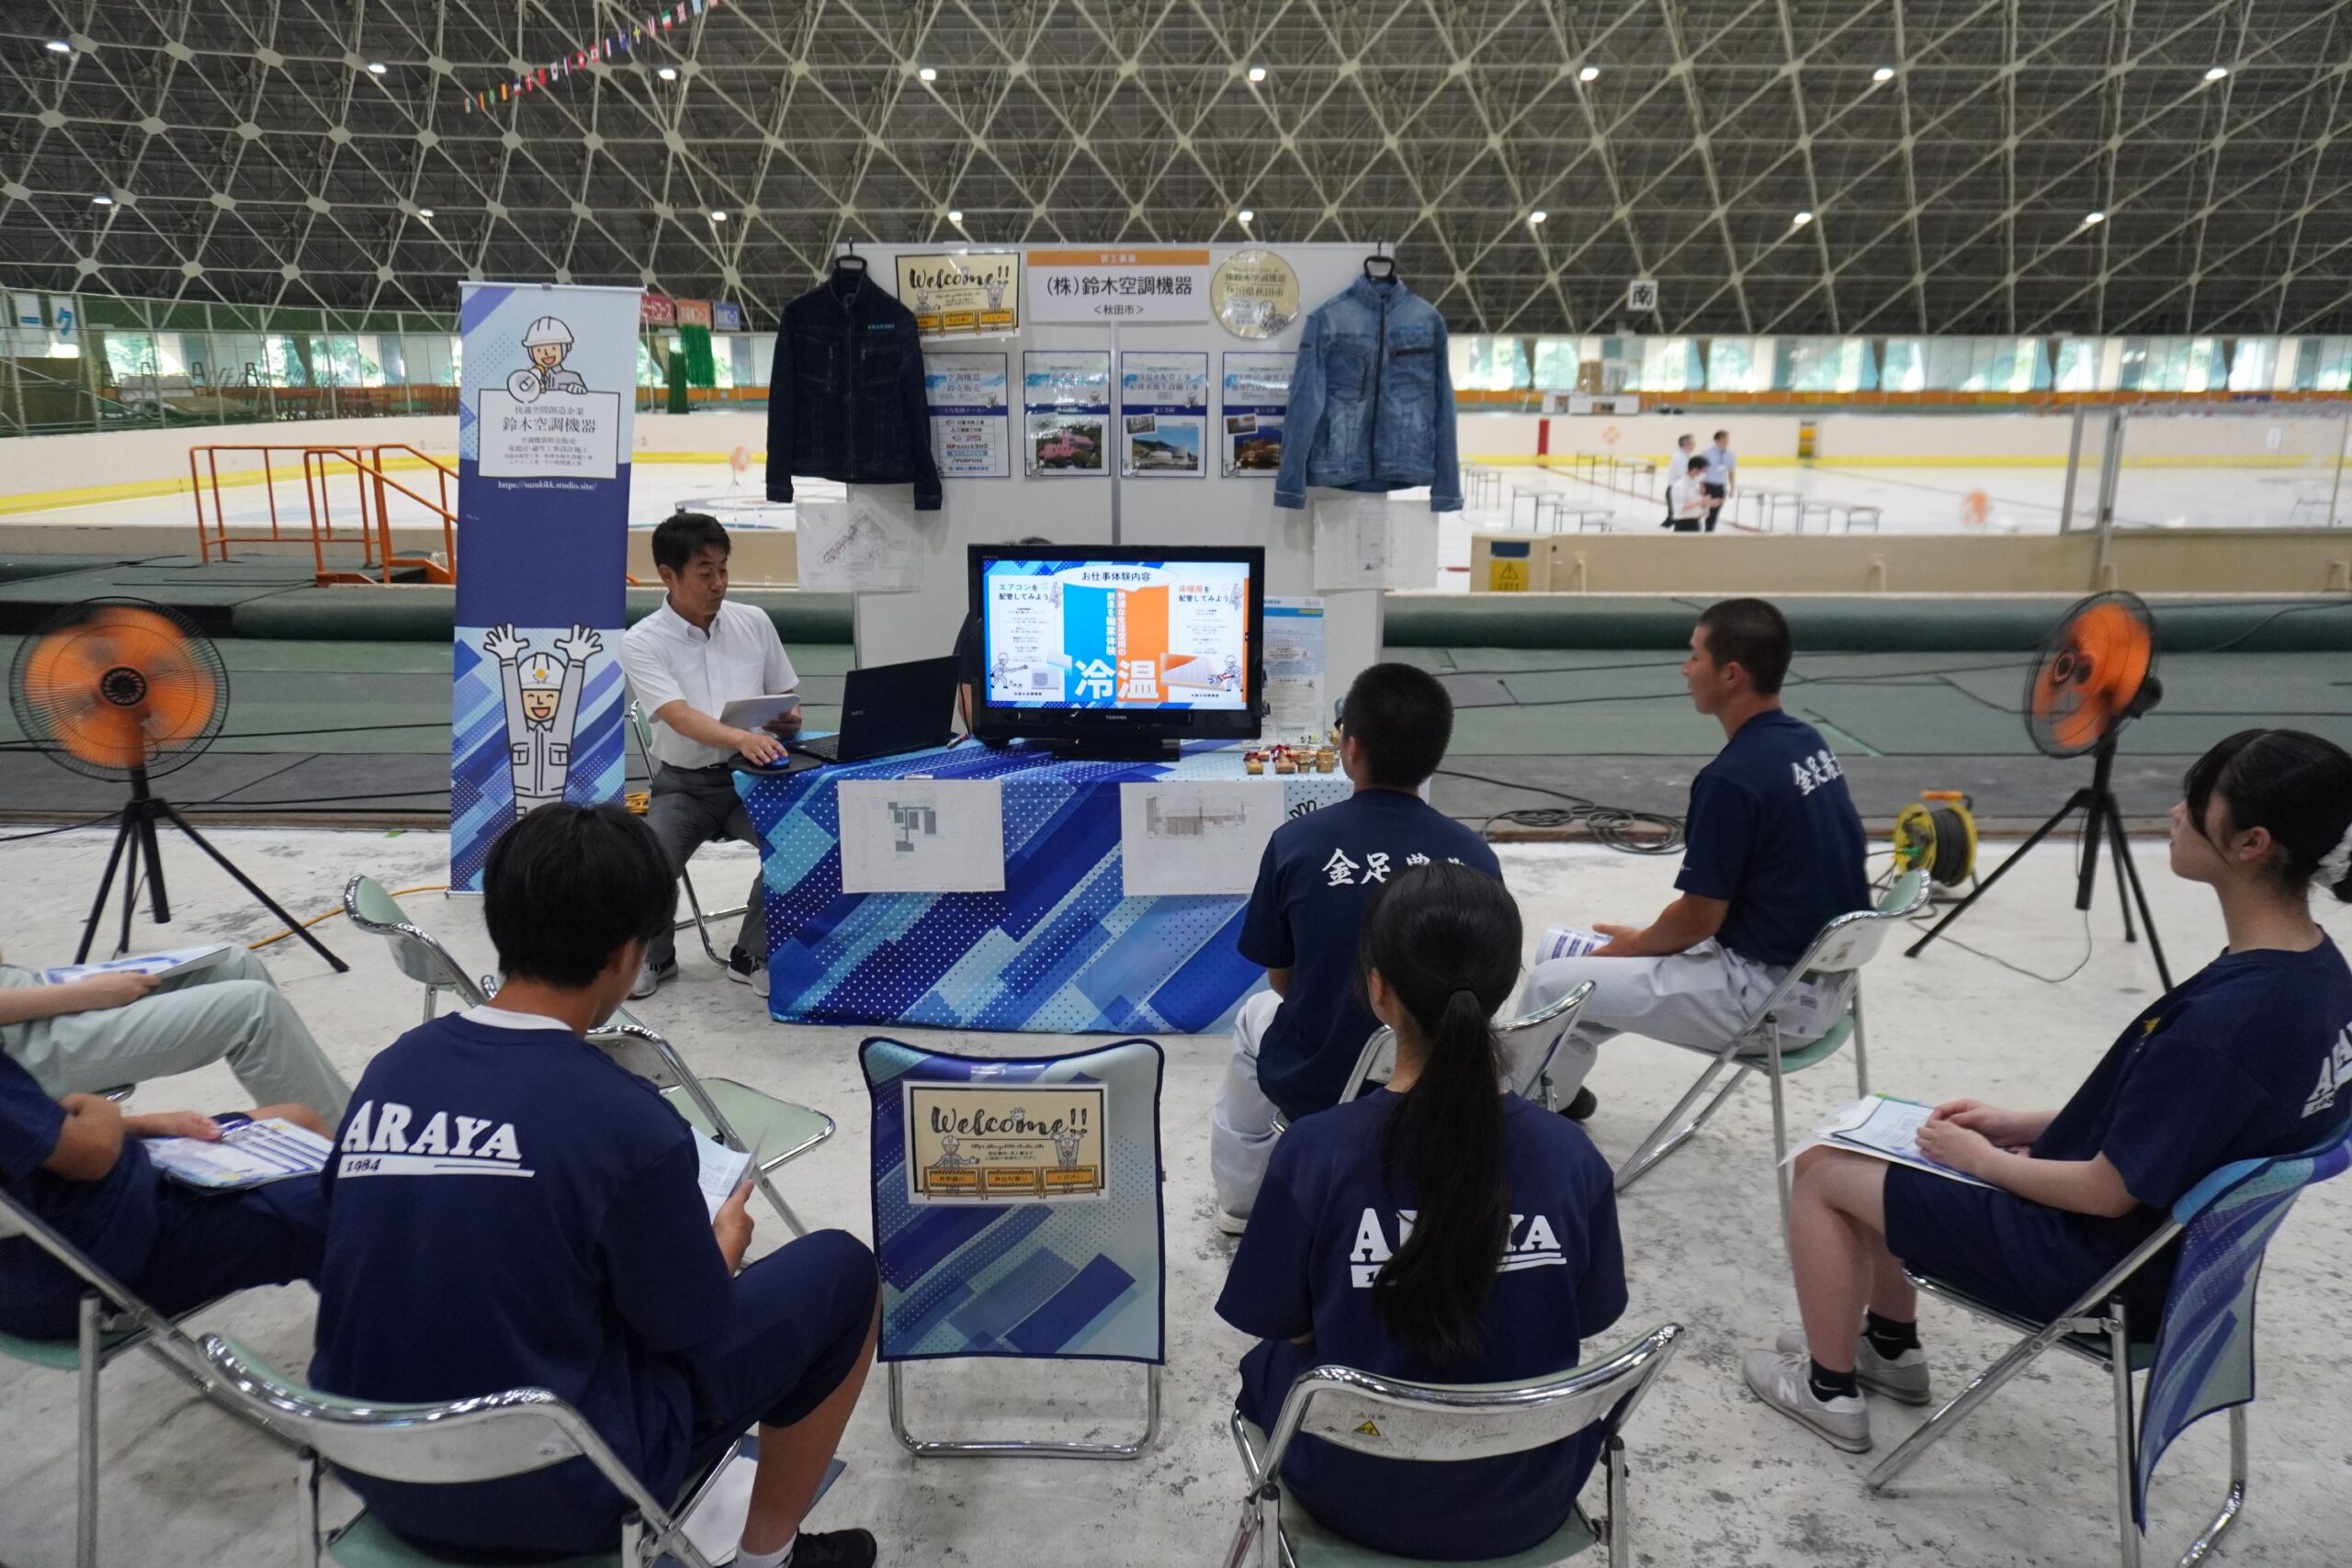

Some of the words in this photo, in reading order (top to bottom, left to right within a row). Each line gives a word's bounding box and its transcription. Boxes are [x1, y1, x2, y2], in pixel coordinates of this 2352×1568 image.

[1046, 276, 1193, 297] (株)鈴木空調機器
[1633, 283, 1655, 306] 南
[503, 417, 595, 434] 鈴木空調機器
[1081, 571, 1151, 581] お仕事体験内容
[999, 592, 1048, 601] 配管してみよう
[1000, 583, 1037, 592] エアコンを
[1179, 594, 1229, 603] 配管してみよう
[1074, 658, 1116, 699] 冷
[1117, 659, 1159, 699] 温
[1321, 848, 1466, 887] 金足
[340, 1100, 523, 1160] ARAYA
[931, 1105, 1089, 1137] Welcome!!
[345, 1157, 382, 1173] 1984
